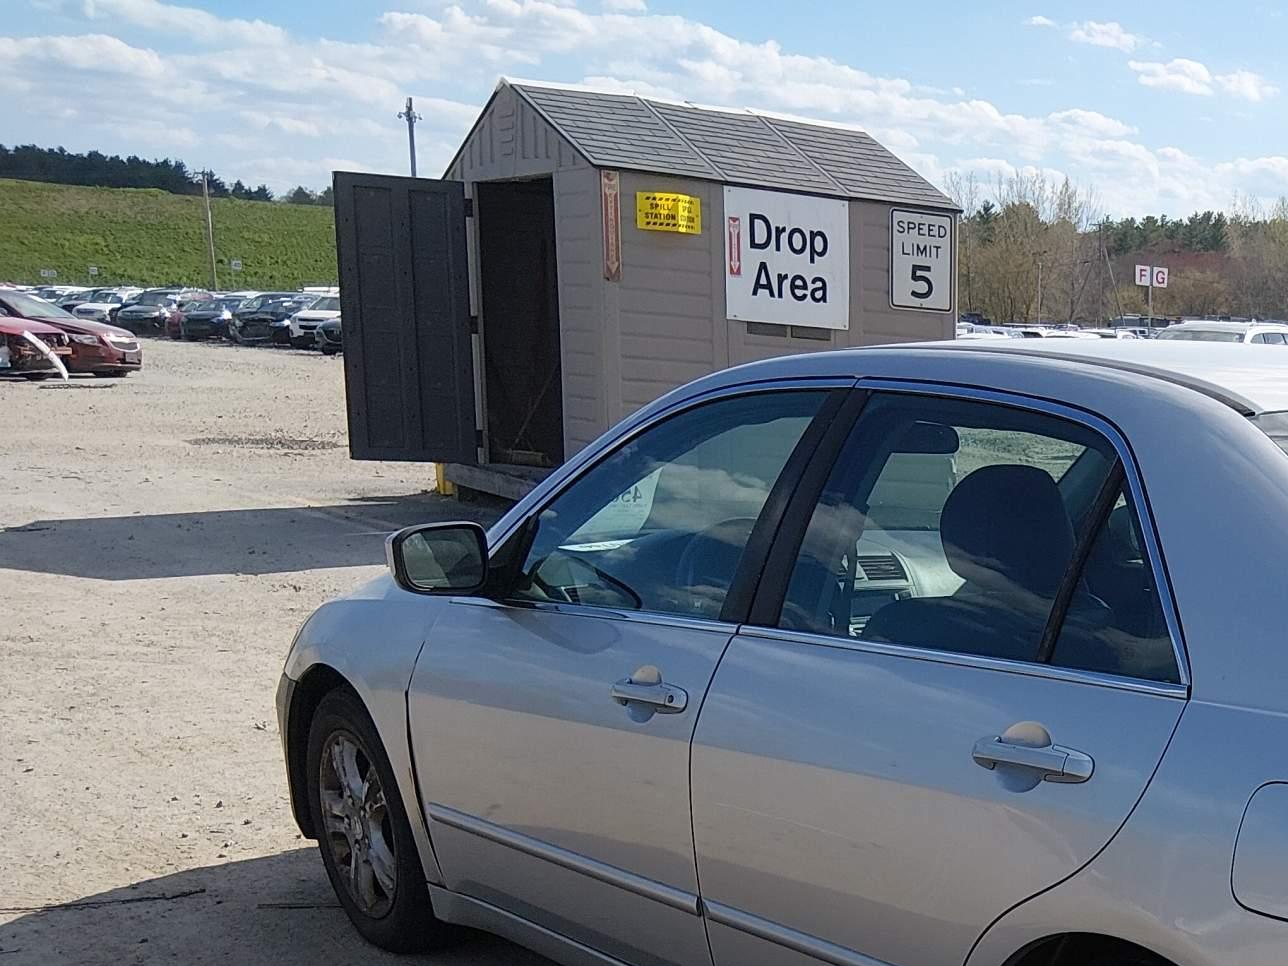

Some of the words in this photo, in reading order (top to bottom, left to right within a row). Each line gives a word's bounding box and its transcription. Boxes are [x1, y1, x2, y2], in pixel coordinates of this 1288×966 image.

[644, 212, 676, 221] STATION
[649, 203, 672, 211] SPILL
[748, 212, 829, 264] Drop
[897, 219, 948, 239] SPEED
[901, 240, 941, 259] LIMIT
[751, 261, 828, 304] Area
[910, 264, 934, 299] 5
[1139, 269, 1147, 282] F
[1156, 270, 1165, 284] G
